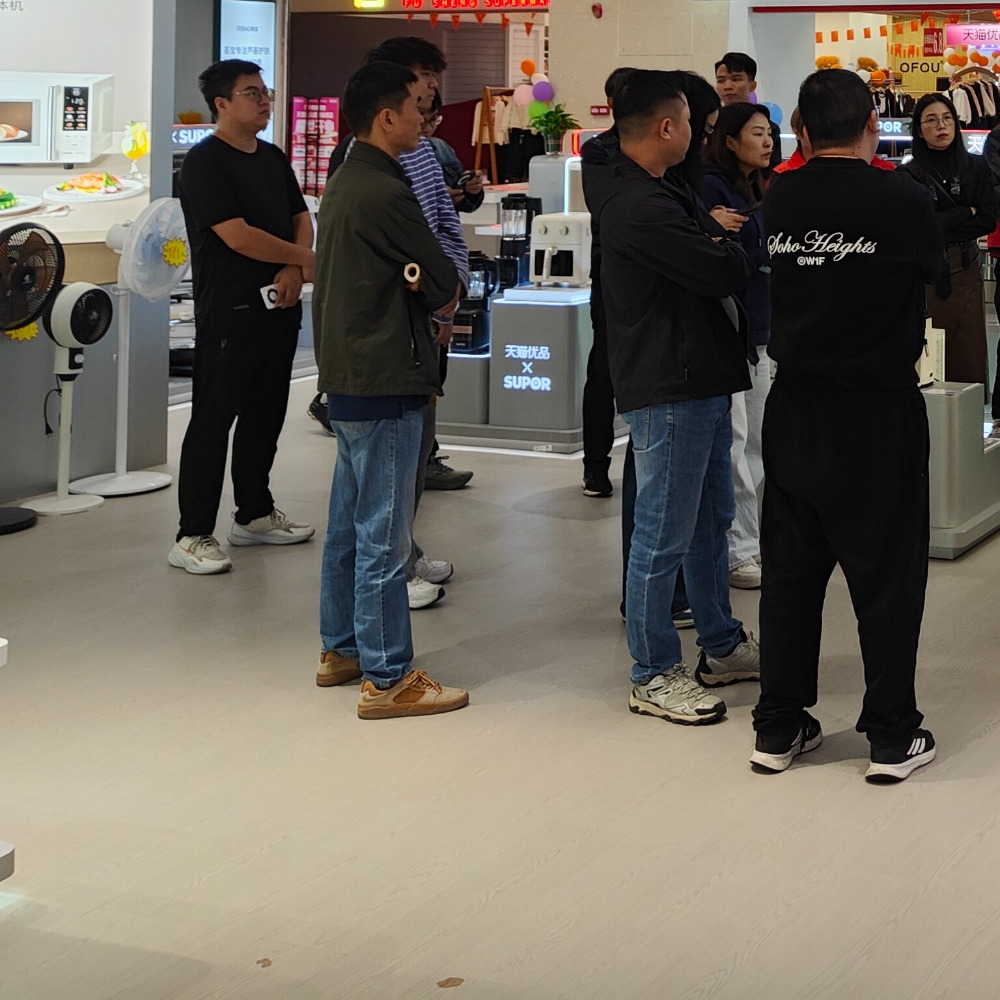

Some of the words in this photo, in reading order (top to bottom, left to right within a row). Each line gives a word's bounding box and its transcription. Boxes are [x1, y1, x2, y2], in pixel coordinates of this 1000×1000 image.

[178, 129, 214, 144] SUP
[767, 232, 802, 259] Soho
[801, 230, 878, 262] Heights
[504, 344, 551, 360] 天猫优品
[503, 375, 551, 391] SUPOR
